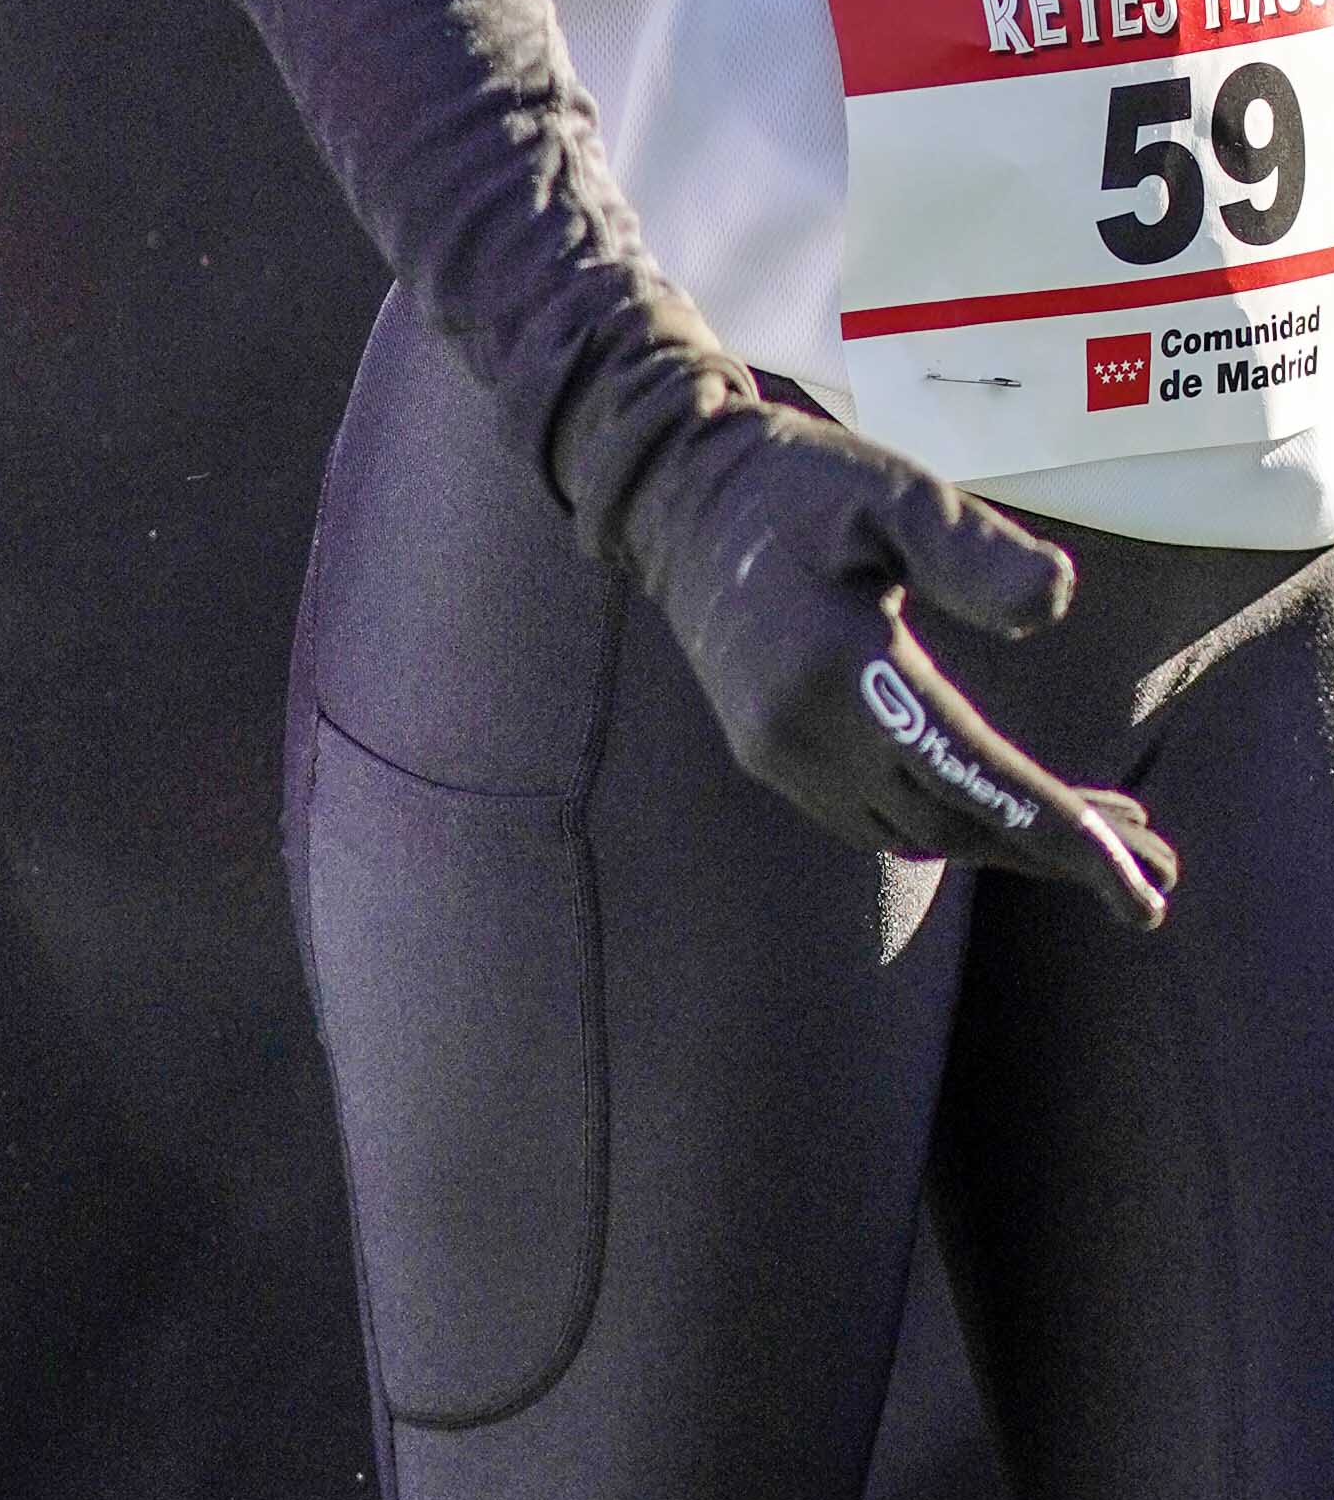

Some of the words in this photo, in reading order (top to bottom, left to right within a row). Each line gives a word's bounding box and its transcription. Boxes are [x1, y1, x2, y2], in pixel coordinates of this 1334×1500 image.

[1096, 62, 1307, 266] 59
[1160, 304, 1320, 358] Comunidad
[1160, 369, 1202, 402] de
[1217, 345, 1318, 394] Madrid
[918, 726, 1040, 829] Kalenji
